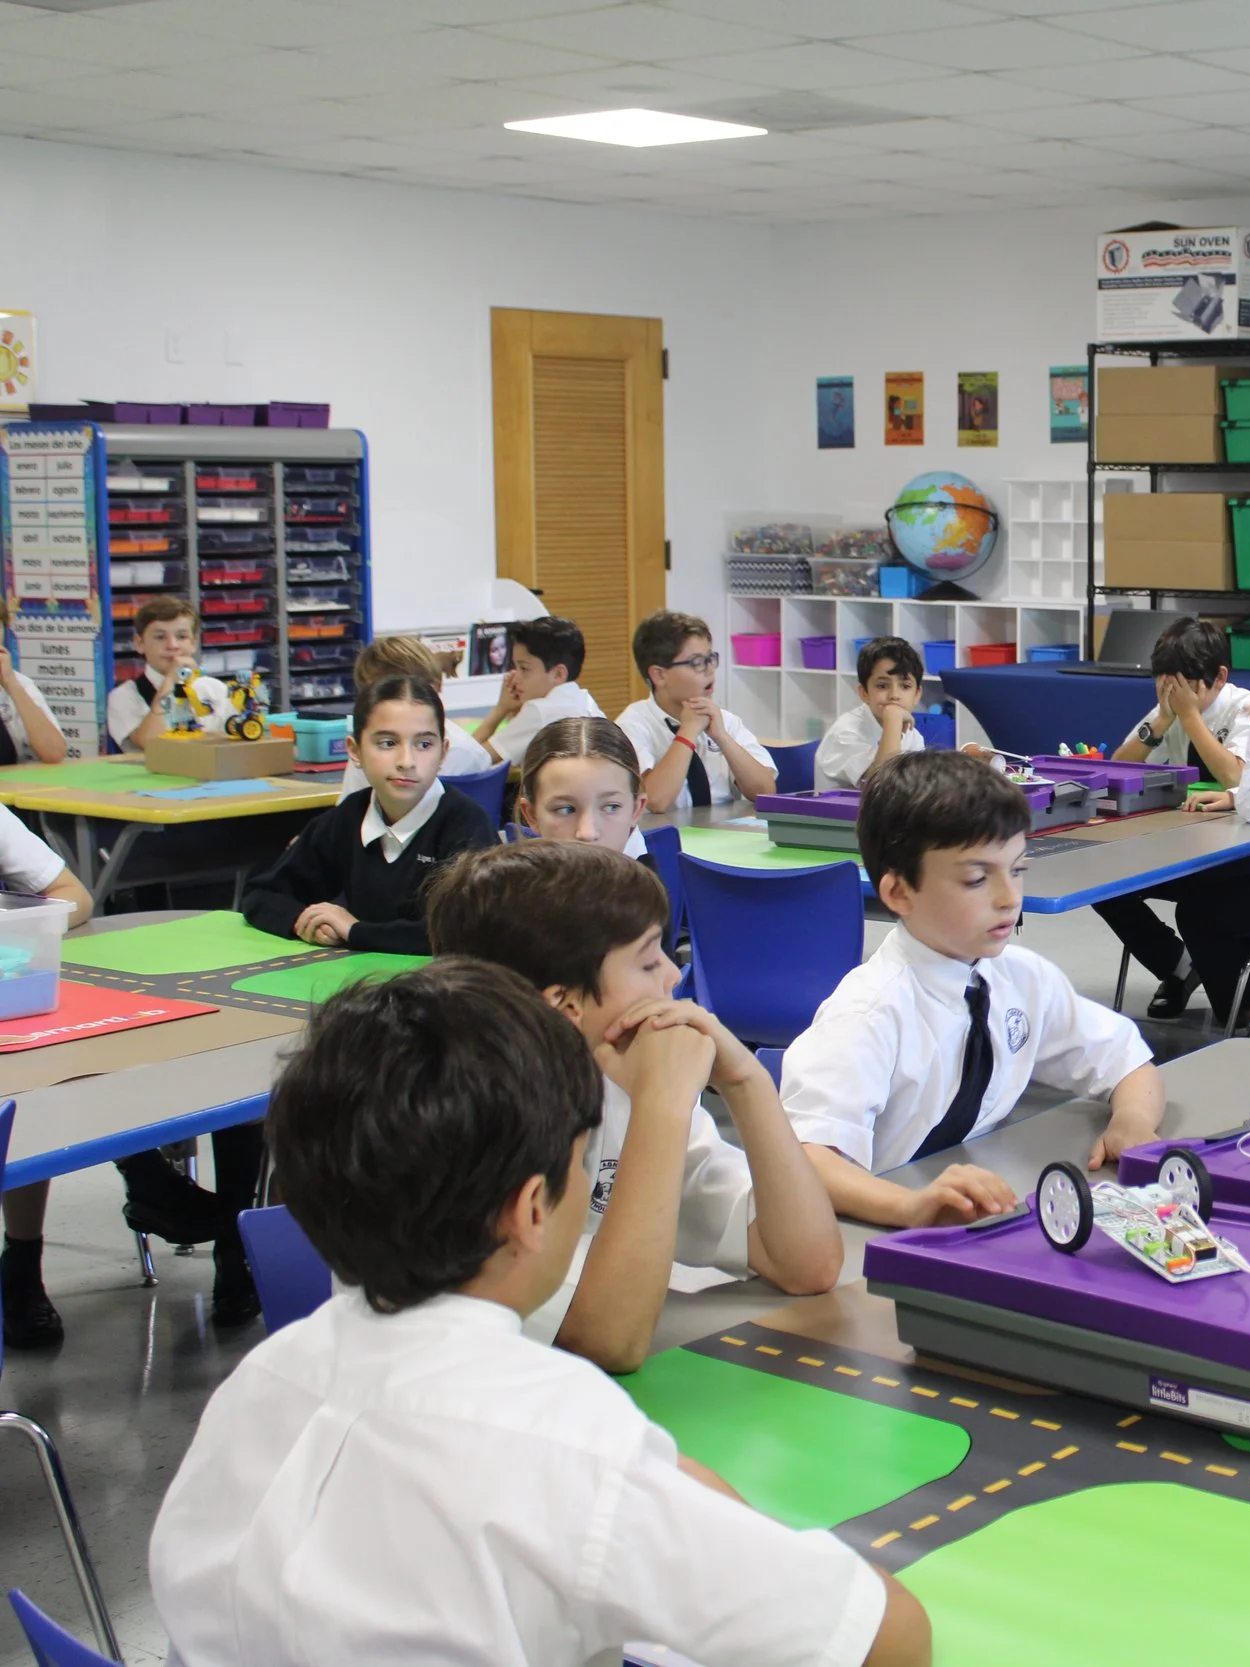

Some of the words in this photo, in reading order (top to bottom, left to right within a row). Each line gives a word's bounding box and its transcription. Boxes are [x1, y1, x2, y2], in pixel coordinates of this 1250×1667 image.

[1173, 237, 1196, 248] SUN
[1199, 236, 1230, 247] OVEN
[41, 643, 70, 656] lunes
[38, 664, 76, 676] martes
[1152, 1385, 1186, 1404] littleBits
